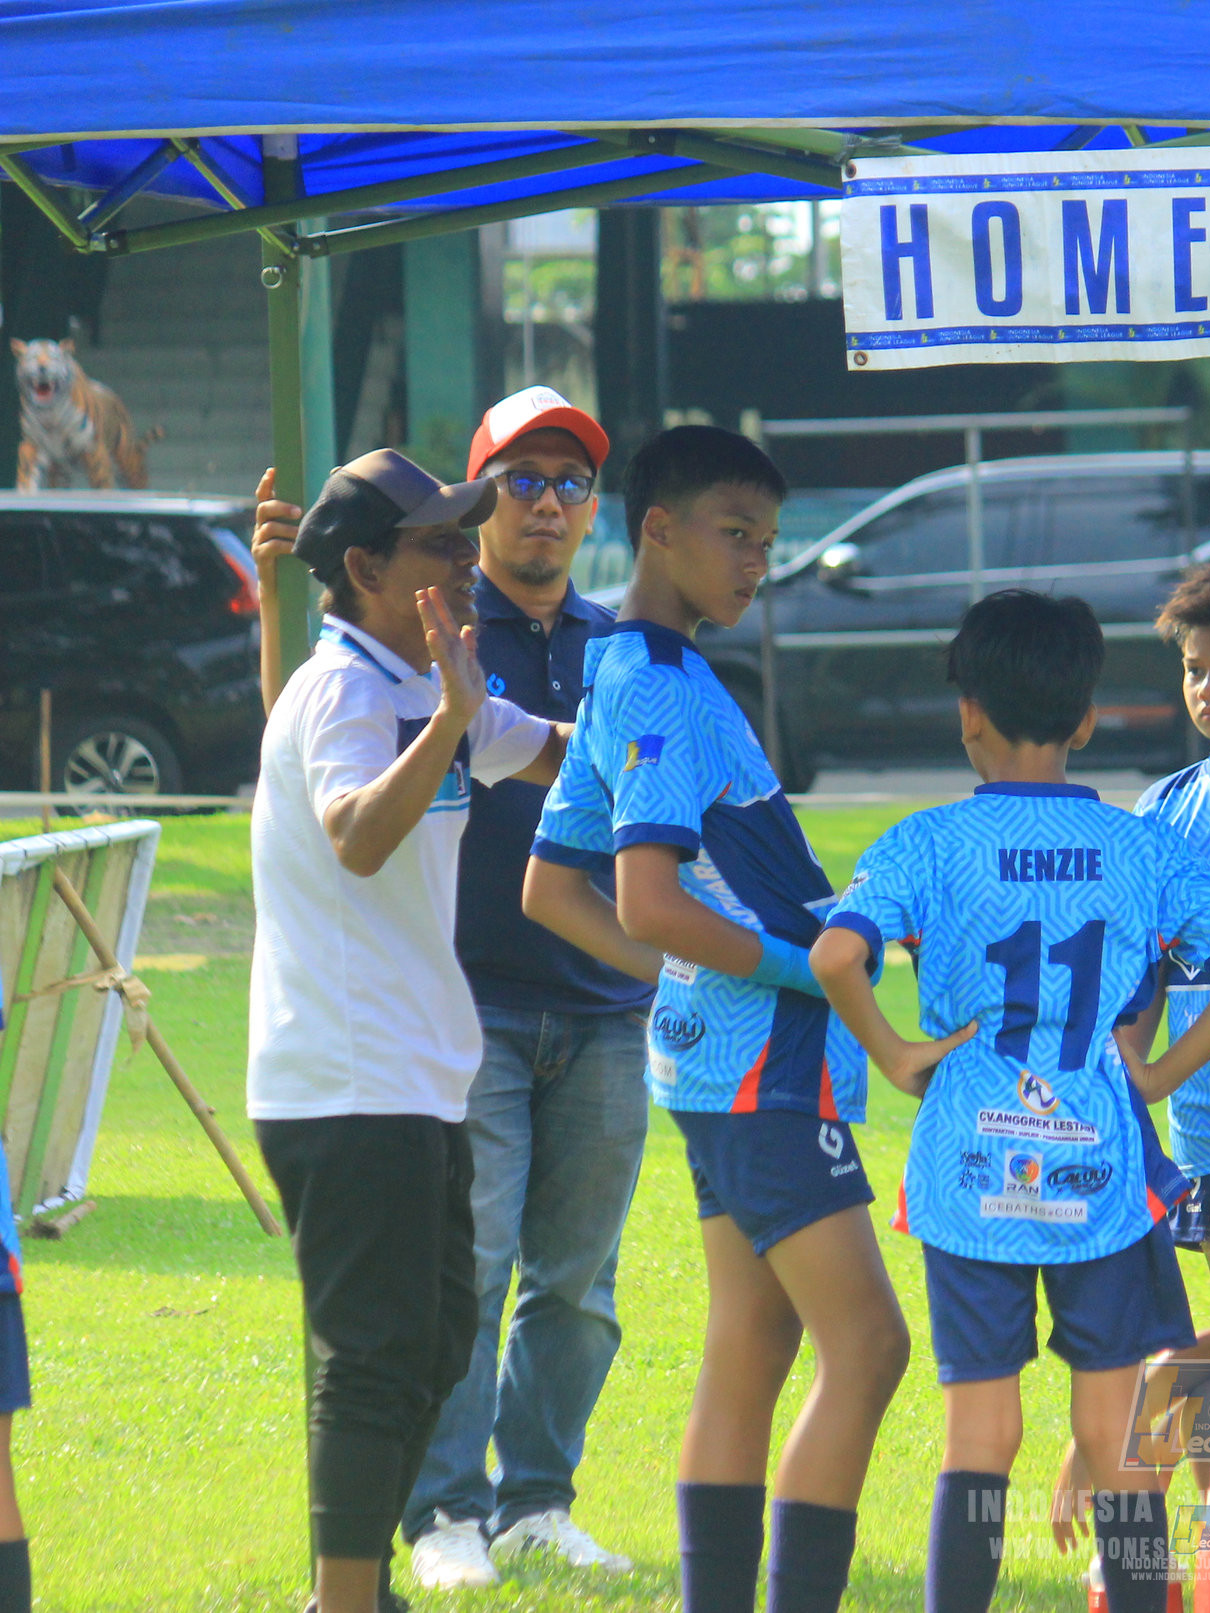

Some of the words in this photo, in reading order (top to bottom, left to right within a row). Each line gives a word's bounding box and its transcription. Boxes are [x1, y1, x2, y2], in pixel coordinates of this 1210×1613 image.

[880, 197, 1208, 320] HOME
[998, 848, 1103, 882] KENZIE
[985, 919, 1106, 1072] 11
[1006, 1183, 1039, 1195] RAN
